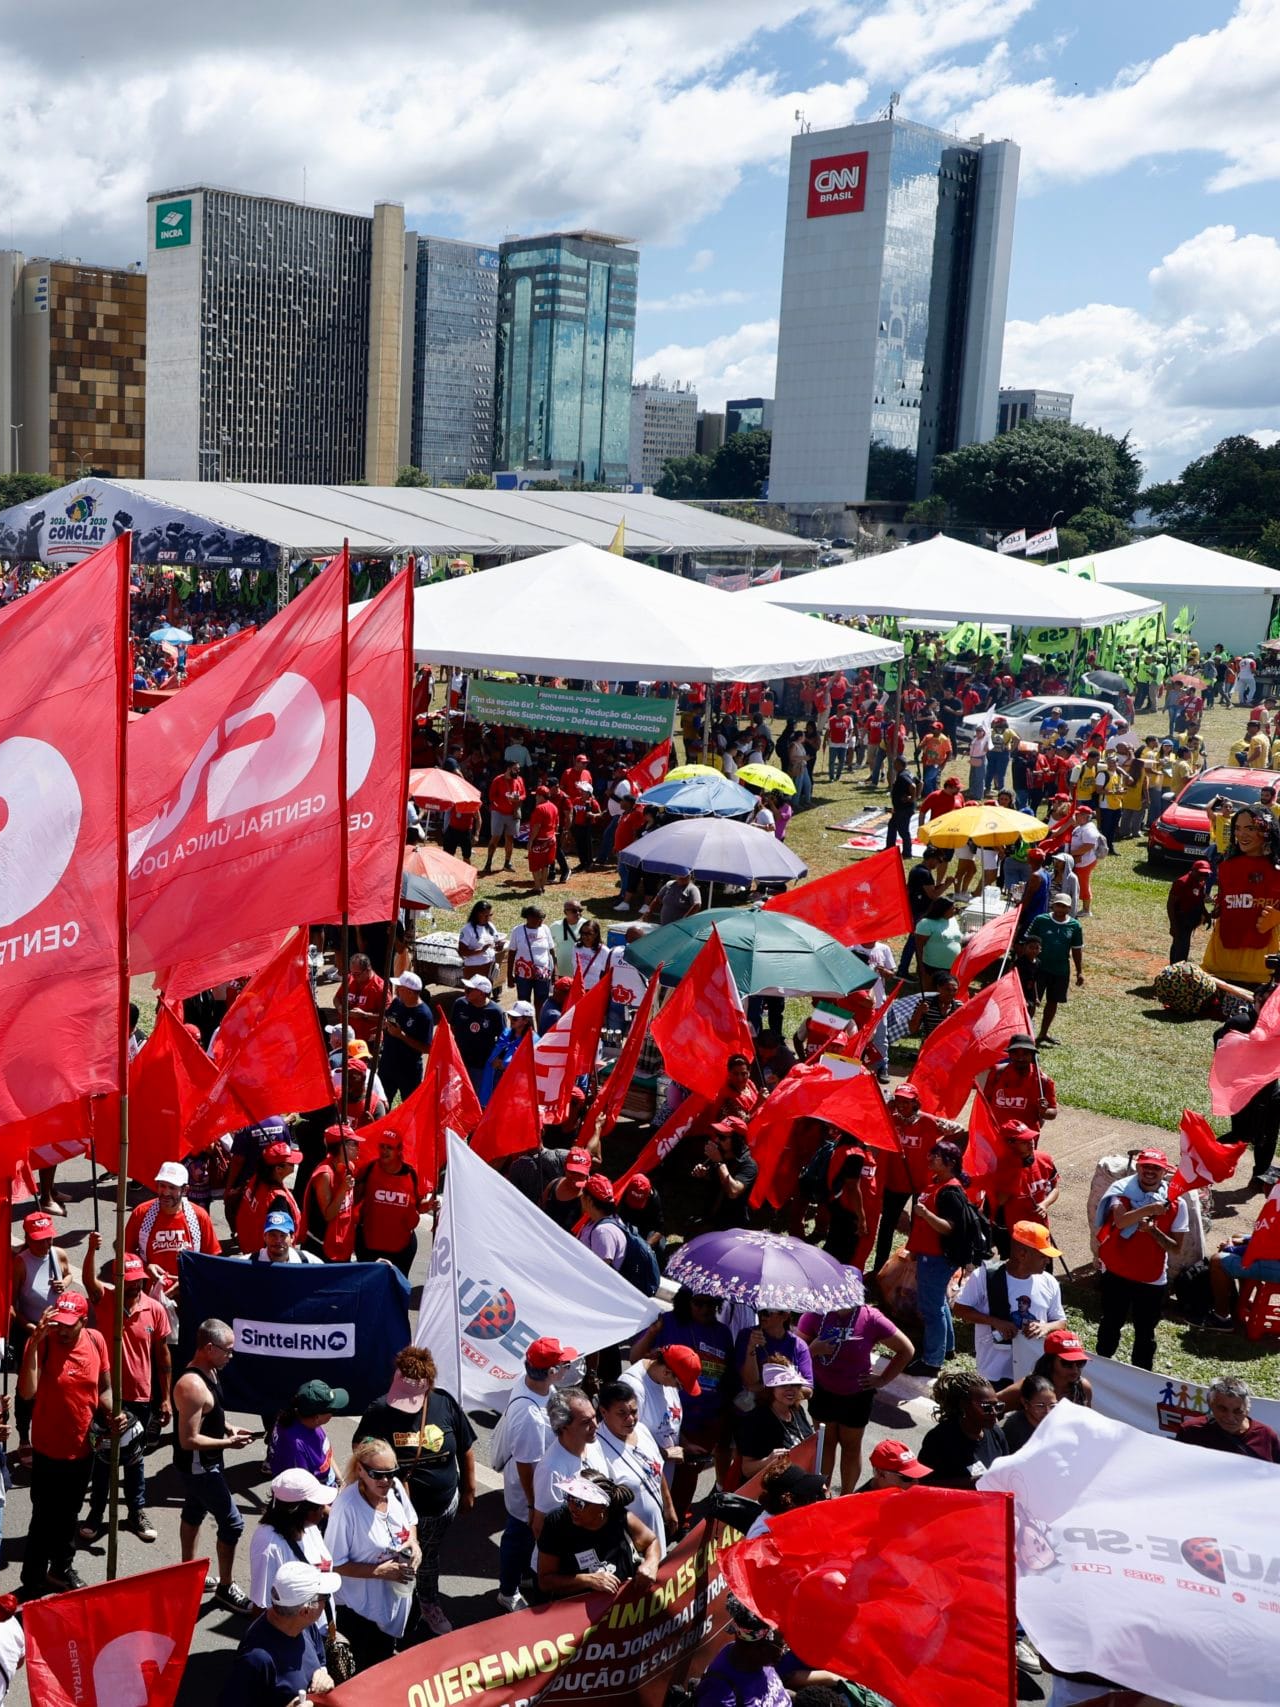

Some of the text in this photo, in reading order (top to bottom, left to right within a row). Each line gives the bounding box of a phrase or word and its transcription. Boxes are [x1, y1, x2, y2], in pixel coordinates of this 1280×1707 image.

[814, 166, 860, 193] CNN
[820, 192, 854, 203] BRASIL
[160, 229, 183, 239] INCRA
[48, 525, 106, 541] CONCLAT
[471, 695, 667, 724] Fim da escala 6x1 Soberania Redução da Jornada
[476, 706, 660, 733] Taxação dos Super-ricos Defesa da Democracia
[996, 1096, 1024, 1106] CUT
[375, 1189, 407, 1204] CUT
[155, 1230, 185, 1242] CUT
[241, 1328, 329, 1350] SinttelRN
[586, 1642, 618, 1661] DA
[620, 1602, 694, 1660] JORNADA
[407, 1633, 576, 1707] QUEREMOS
[649, 1581, 677, 1617] DA
[68, 1640, 83, 1704] CENTRAL
[628, 1663, 649, 1688] DE
